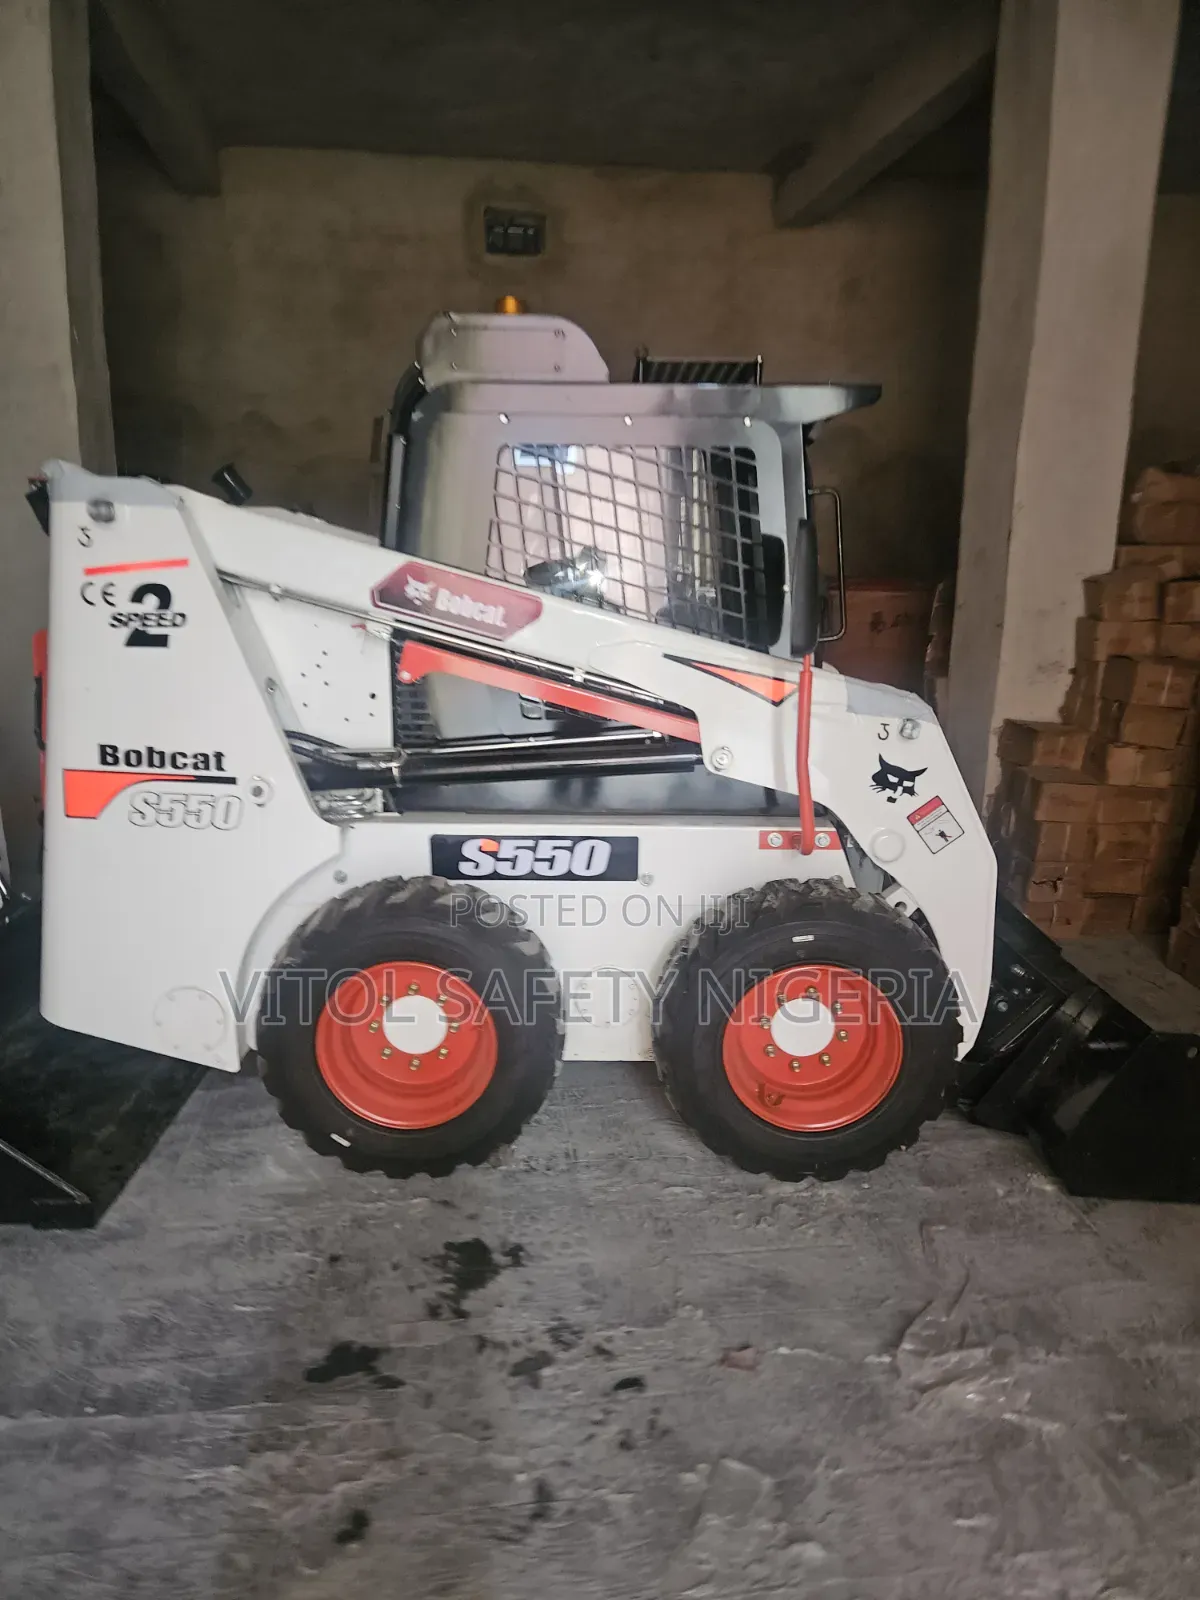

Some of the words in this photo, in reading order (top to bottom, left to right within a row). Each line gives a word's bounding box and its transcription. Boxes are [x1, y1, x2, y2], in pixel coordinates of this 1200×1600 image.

[108, 611, 187, 629] SPEED
[98, 743, 227, 772] Bobcat
[127, 790, 246, 831] S550
[457, 838, 613, 877] S550
